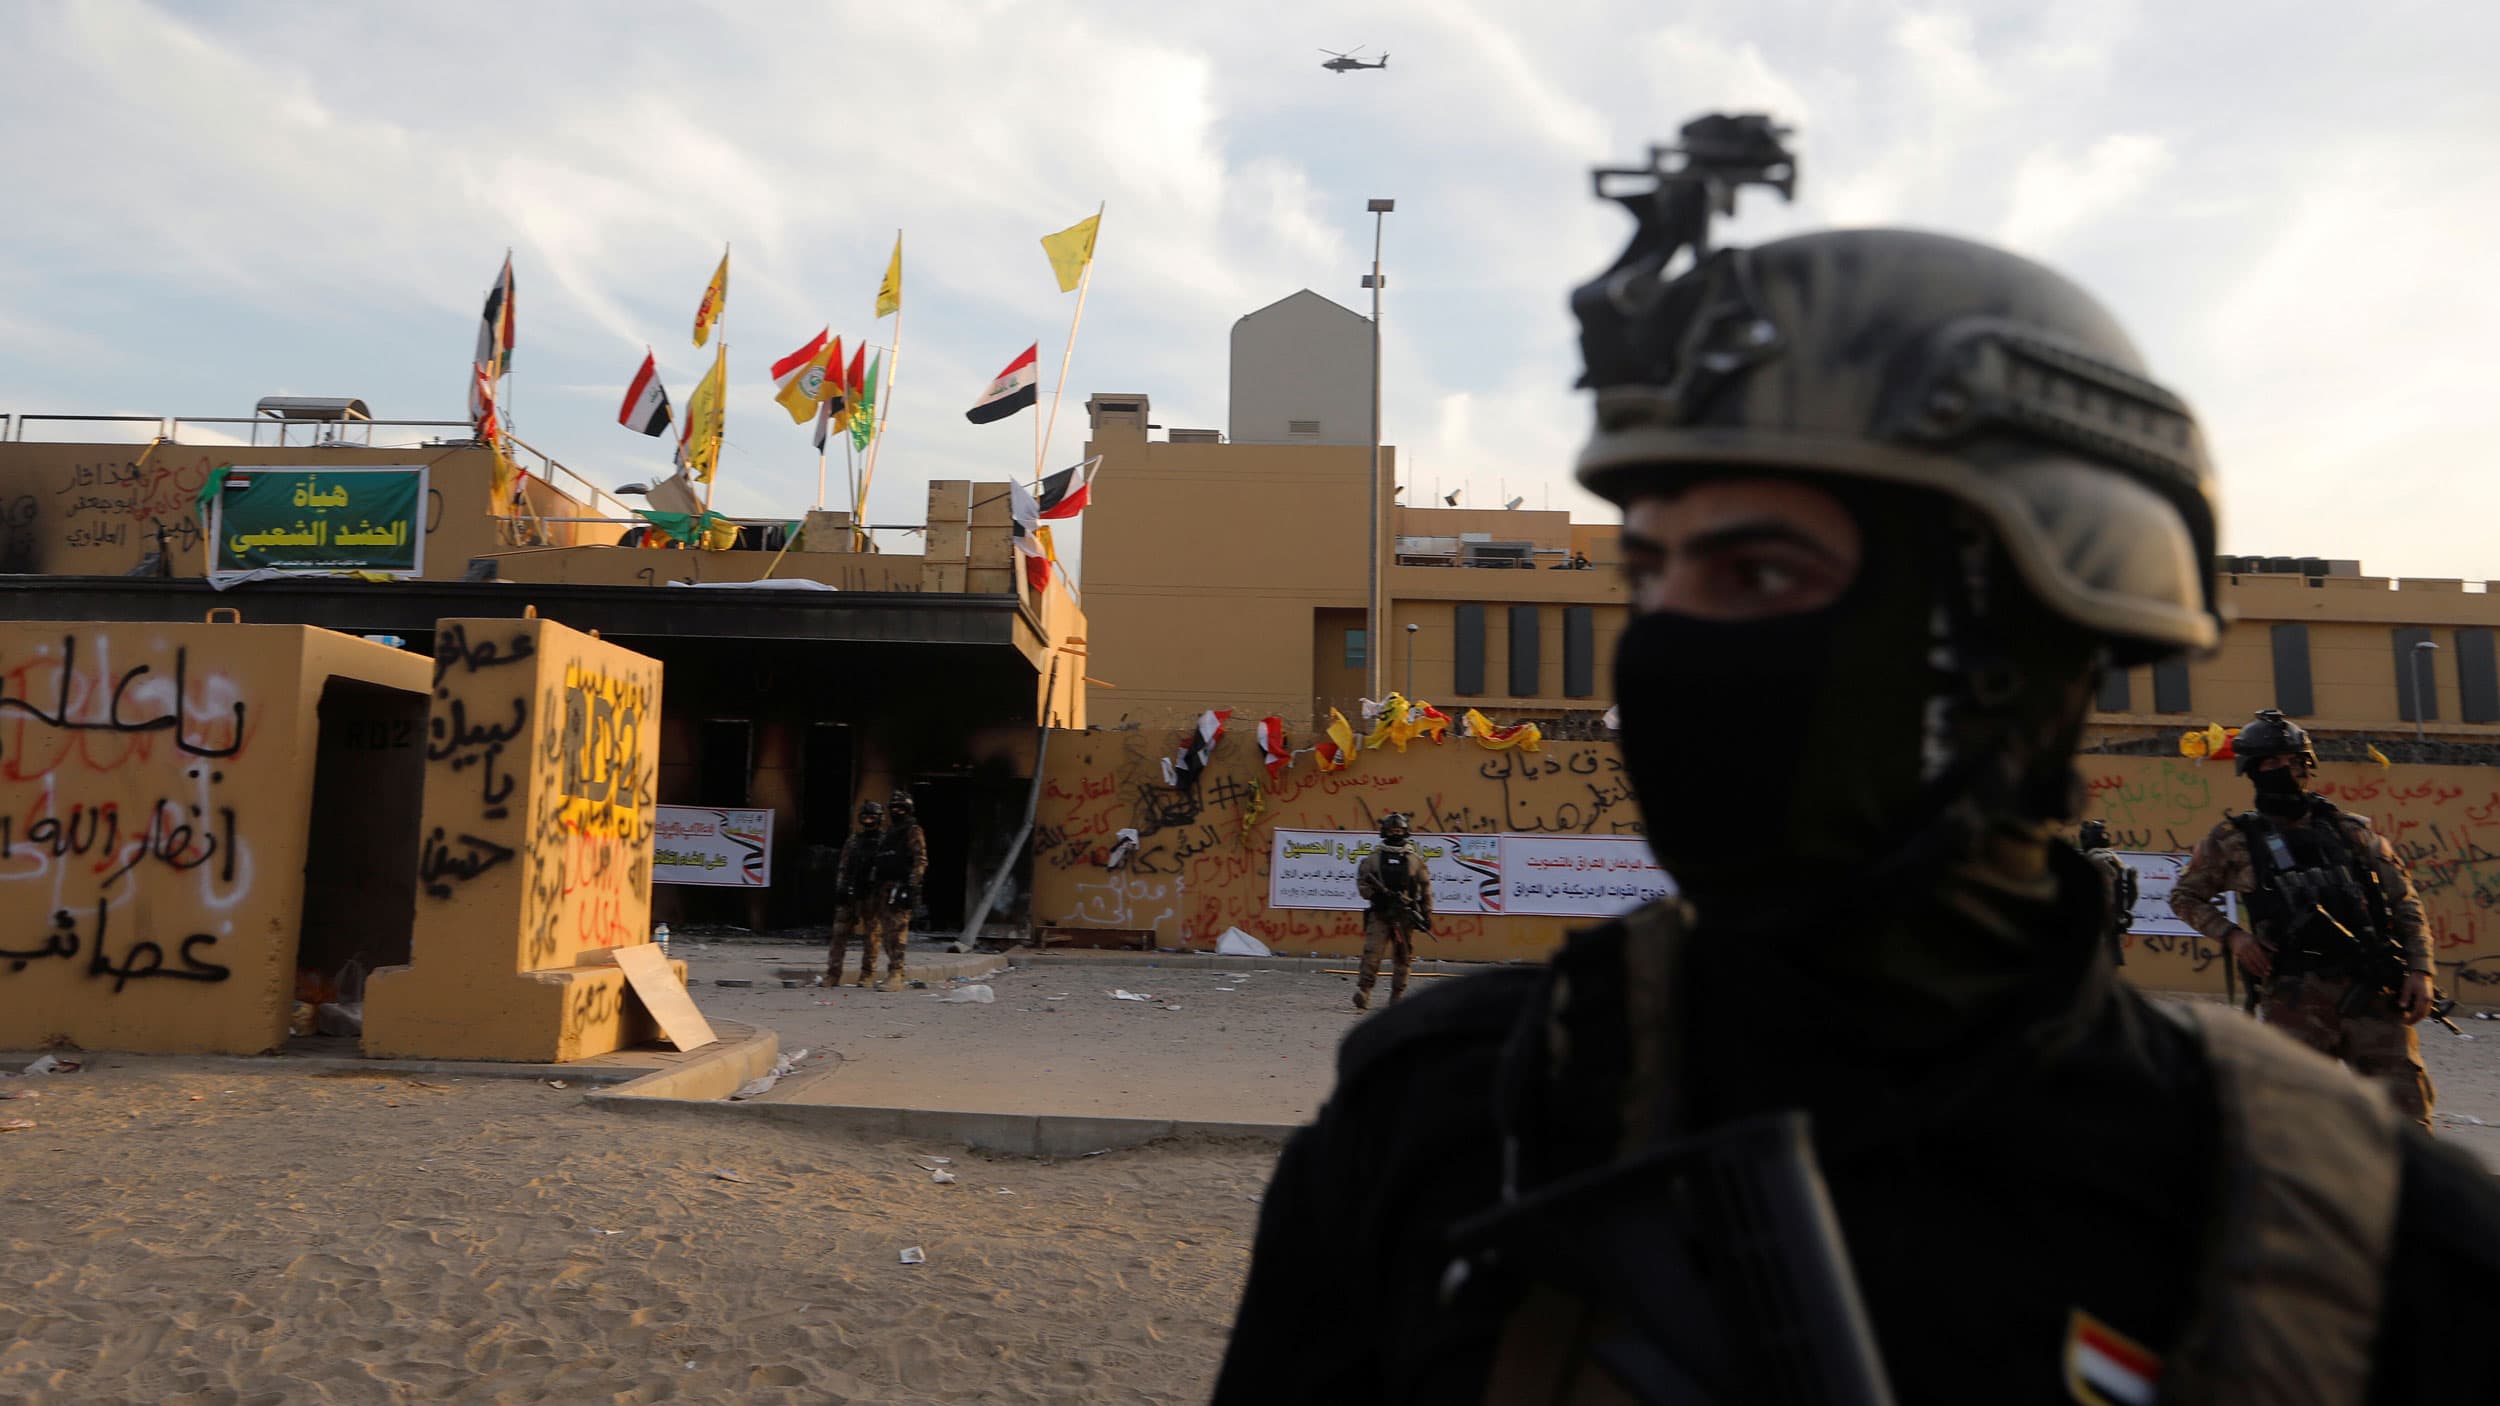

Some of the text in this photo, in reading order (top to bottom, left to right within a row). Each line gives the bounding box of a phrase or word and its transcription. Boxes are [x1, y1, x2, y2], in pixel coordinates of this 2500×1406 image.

[292, 473, 350, 514] هيأة
[229, 518, 328, 558] الشعبي
[335, 518, 407, 546] الحشد
[1282, 838, 1335, 860] الحسين
[1512, 880, 1544, 899] العراق
[1607, 882, 1639, 900] القوات
